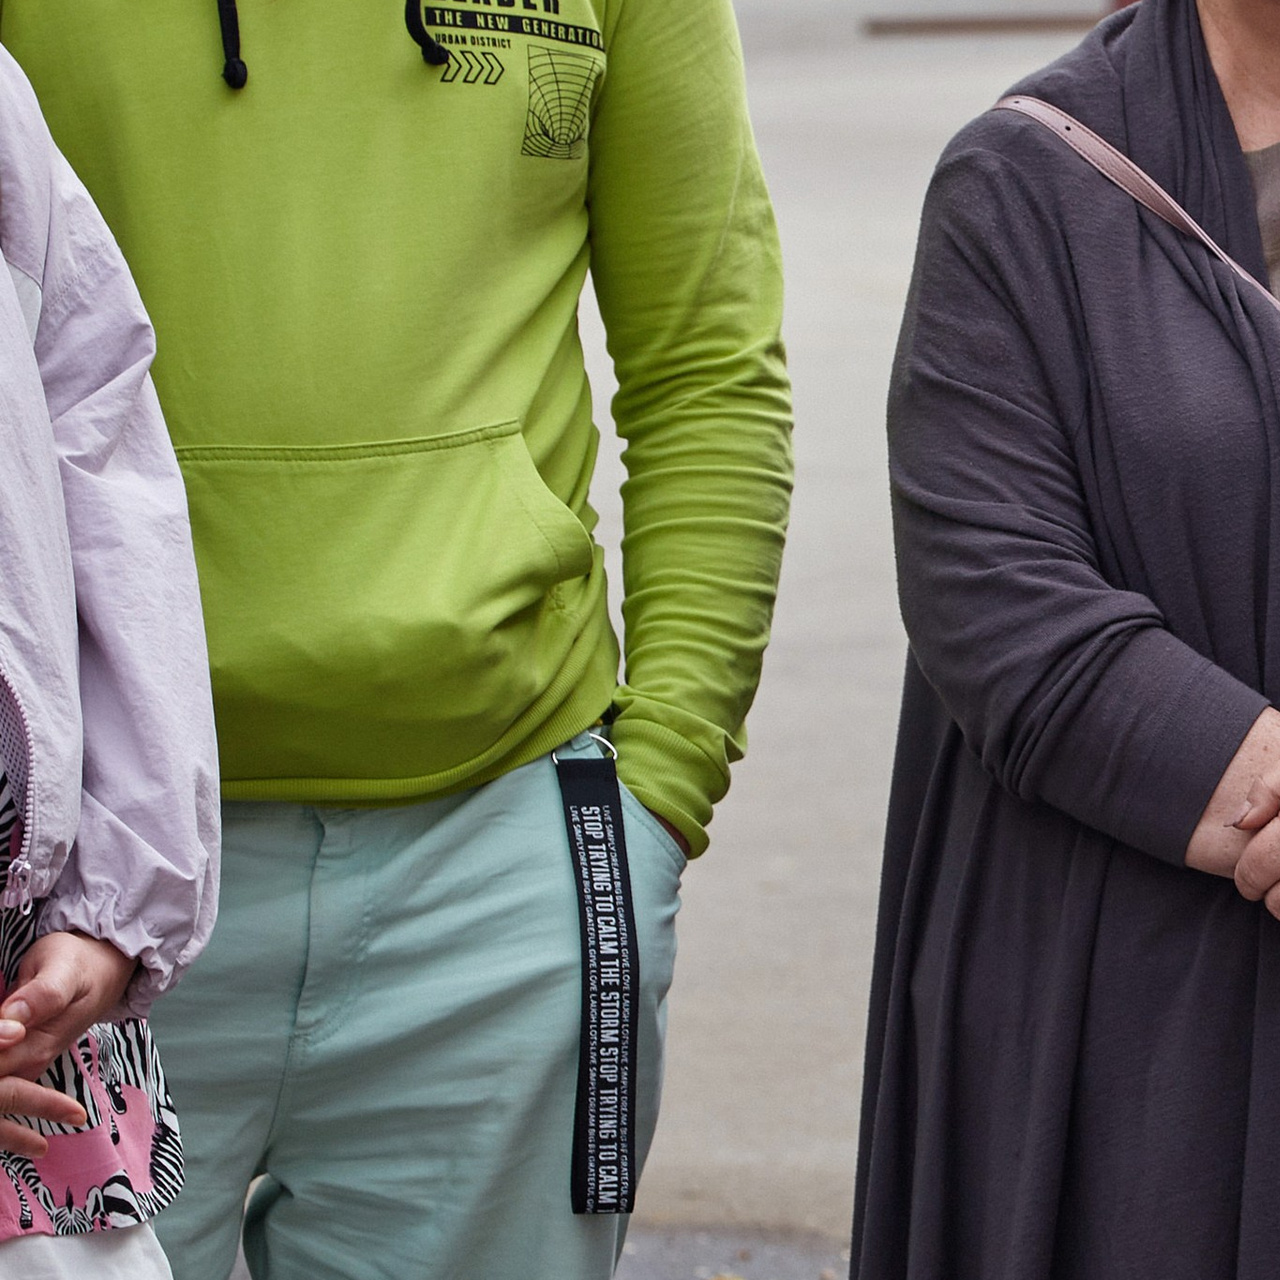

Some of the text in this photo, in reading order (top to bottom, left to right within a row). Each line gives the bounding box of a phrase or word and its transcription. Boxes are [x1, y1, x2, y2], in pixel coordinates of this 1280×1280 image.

[434, 9, 463, 26] THE
[476, 13, 509, 30] NEW
[434, 33, 511, 49] URBAN DISTRICT
[581, 806, 605, 839] STOP
[587, 843, 612, 891] TRYING
[595, 894, 615, 912] TO
[597, 916, 619, 954] CALM
[600, 959, 620, 986] THE
[600, 991, 620, 1043] STORM
[599, 1047, 619, 1082] STOP
[598, 1087, 618, 1138] TRYING
[598, 1142, 618, 1160] TO
[597, 1165, 618, 1204] CALM
